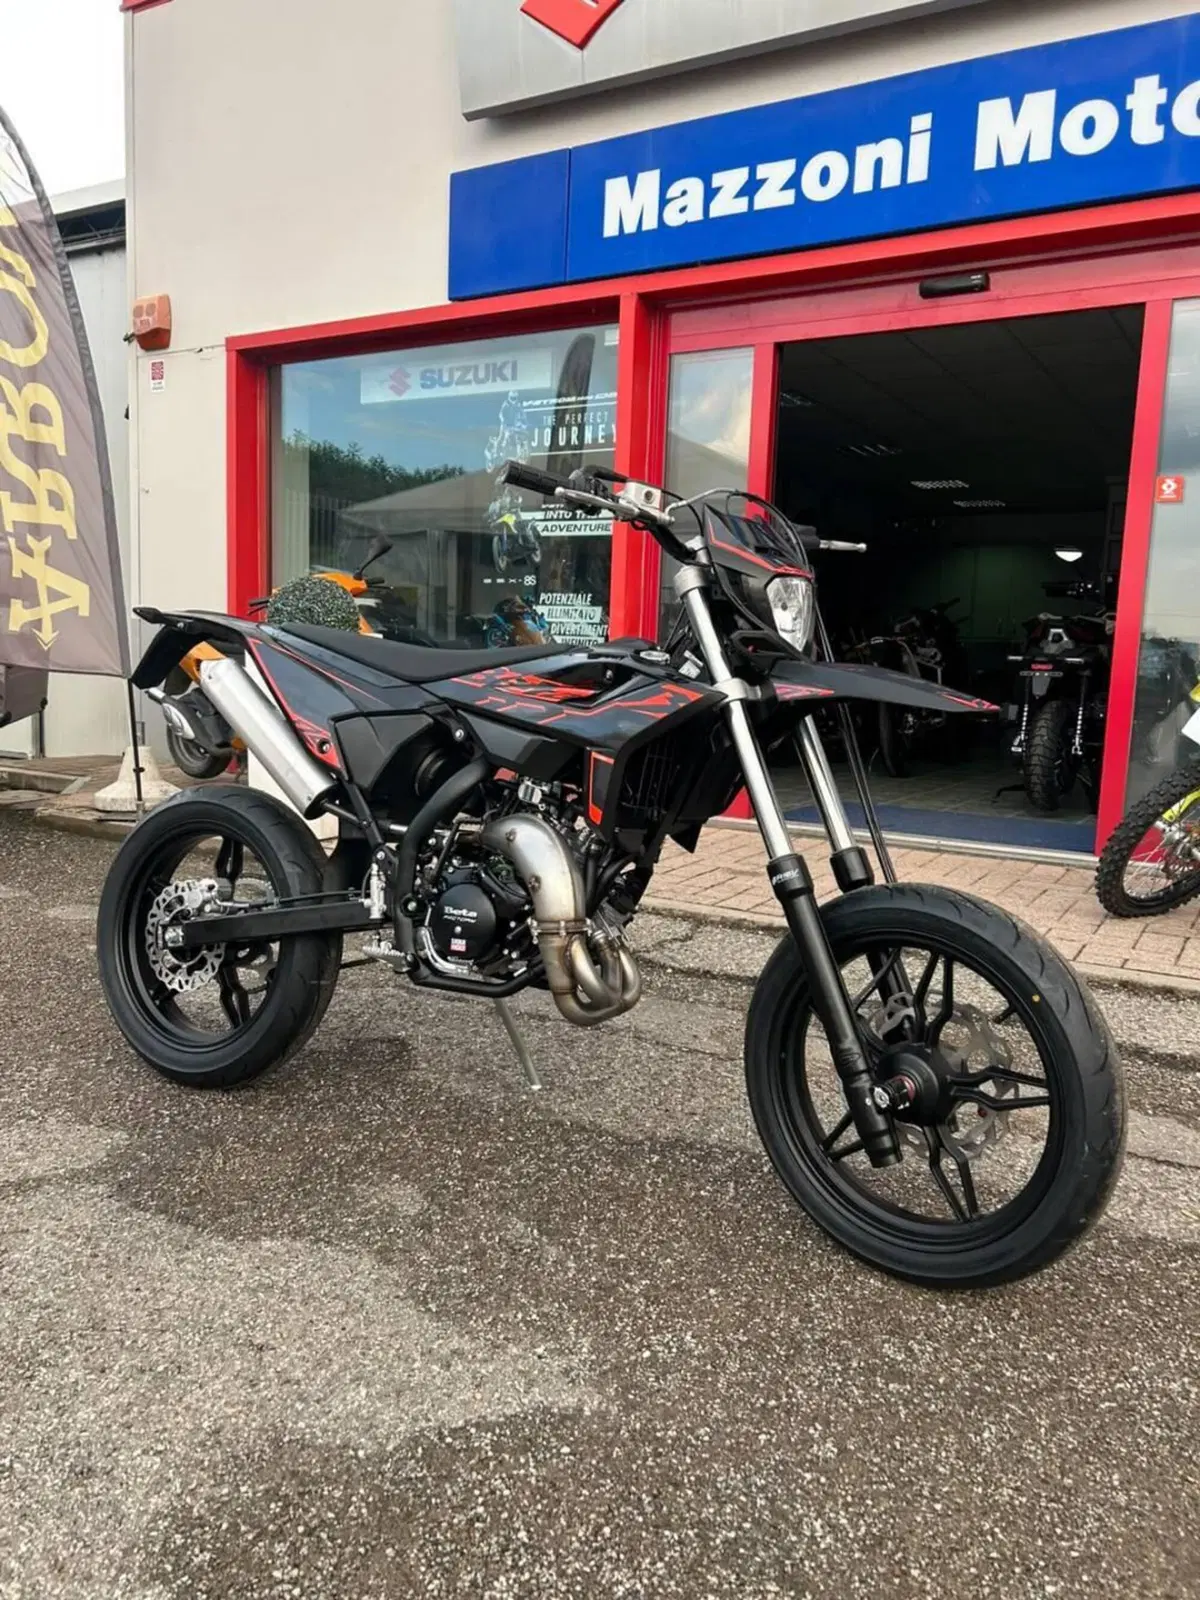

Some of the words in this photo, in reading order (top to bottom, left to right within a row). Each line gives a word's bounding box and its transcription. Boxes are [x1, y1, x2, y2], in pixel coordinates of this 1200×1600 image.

[603, 112, 932, 238] Mazzoni
[420, 360, 517, 389] SUZUKI
[565, 411, 608, 425] PERFECT
[545, 510, 573, 520] INTO
[541, 523, 612, 533] ADVENTURE
[539, 592, 592, 605] POTENZIALE
[547, 608, 597, 620] ILLIMITATO
[550, 622, 610, 636] DIVERTIMENT
[444, 906, 477, 917] Beta
